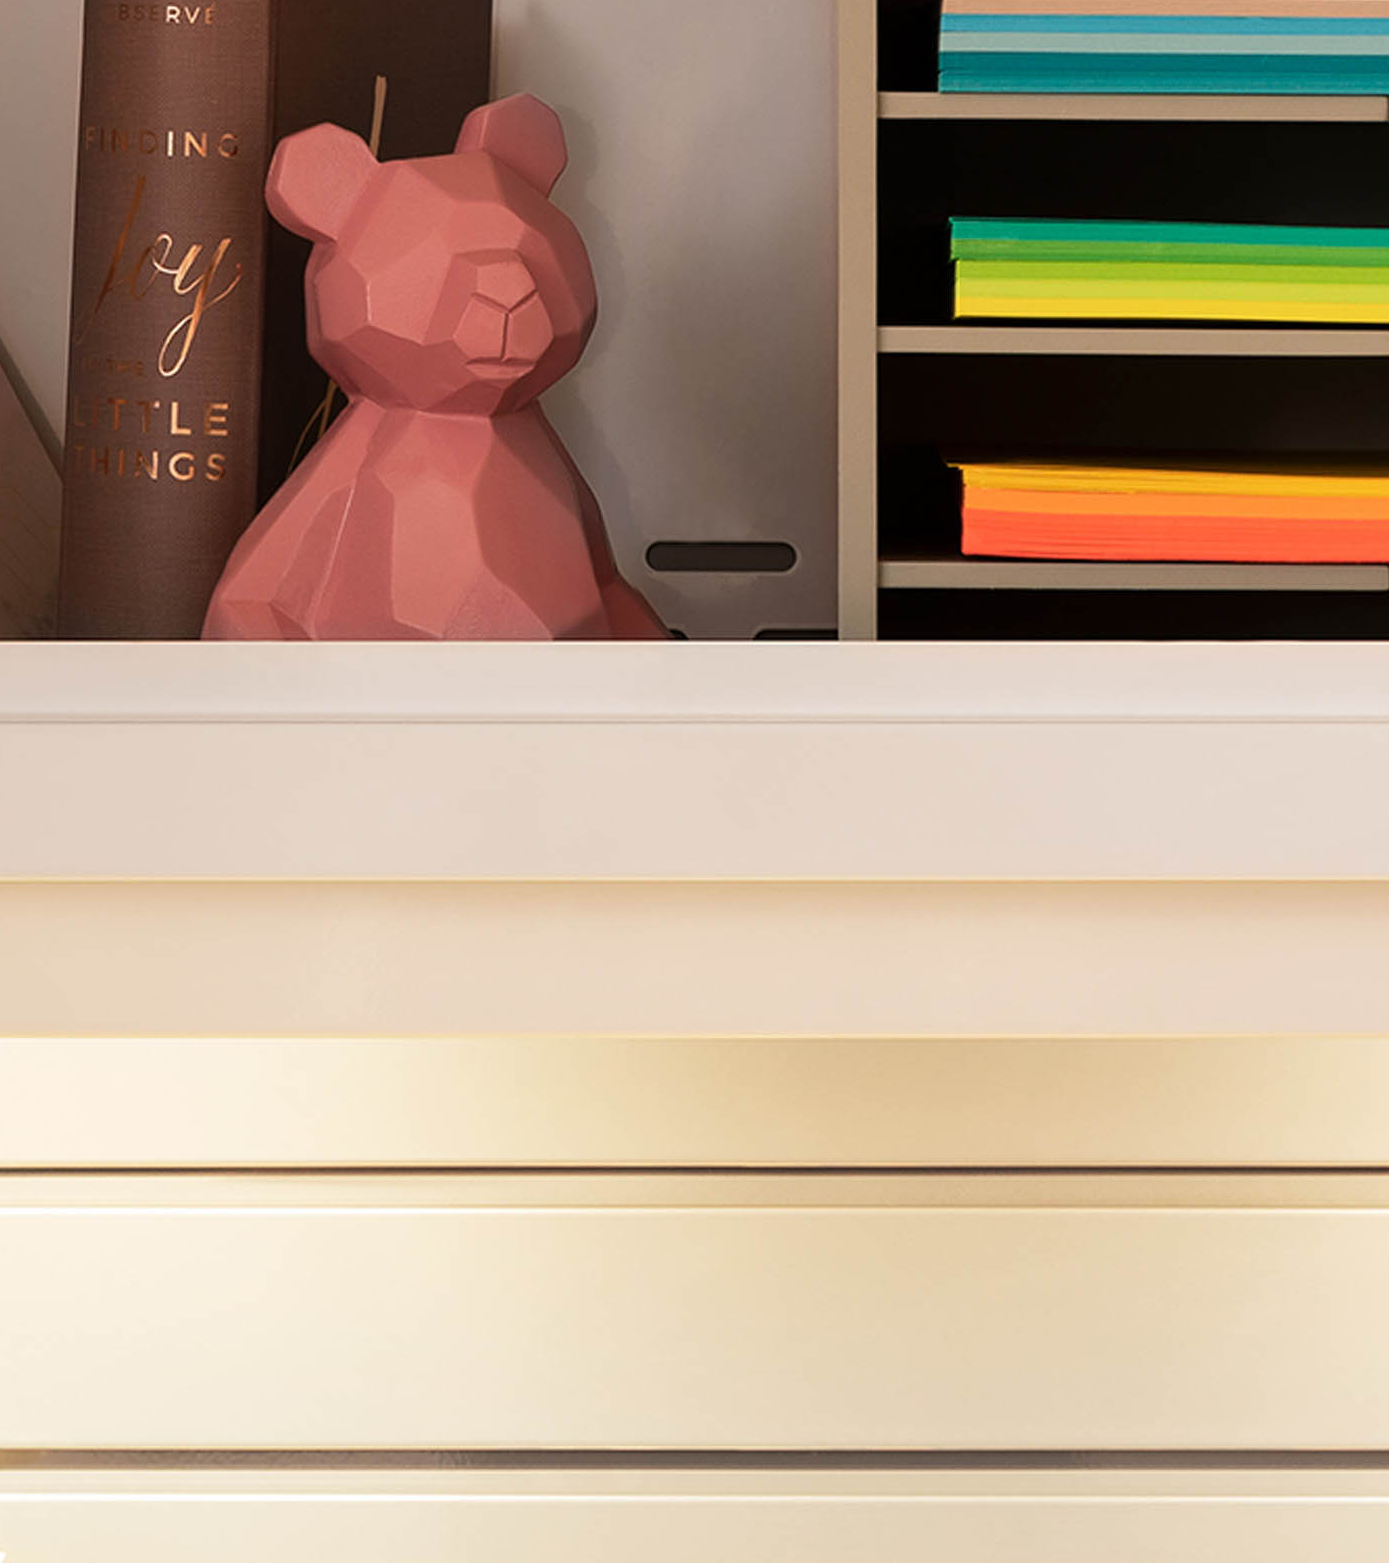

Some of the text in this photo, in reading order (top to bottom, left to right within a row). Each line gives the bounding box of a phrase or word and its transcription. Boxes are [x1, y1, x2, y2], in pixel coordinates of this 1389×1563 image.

[107, 1, 218, 25] BSERVÉ
[83, 126, 240, 159] FINDING
[74, 399, 231, 436] LITTLE
[74, 444, 228, 482] THINGS
